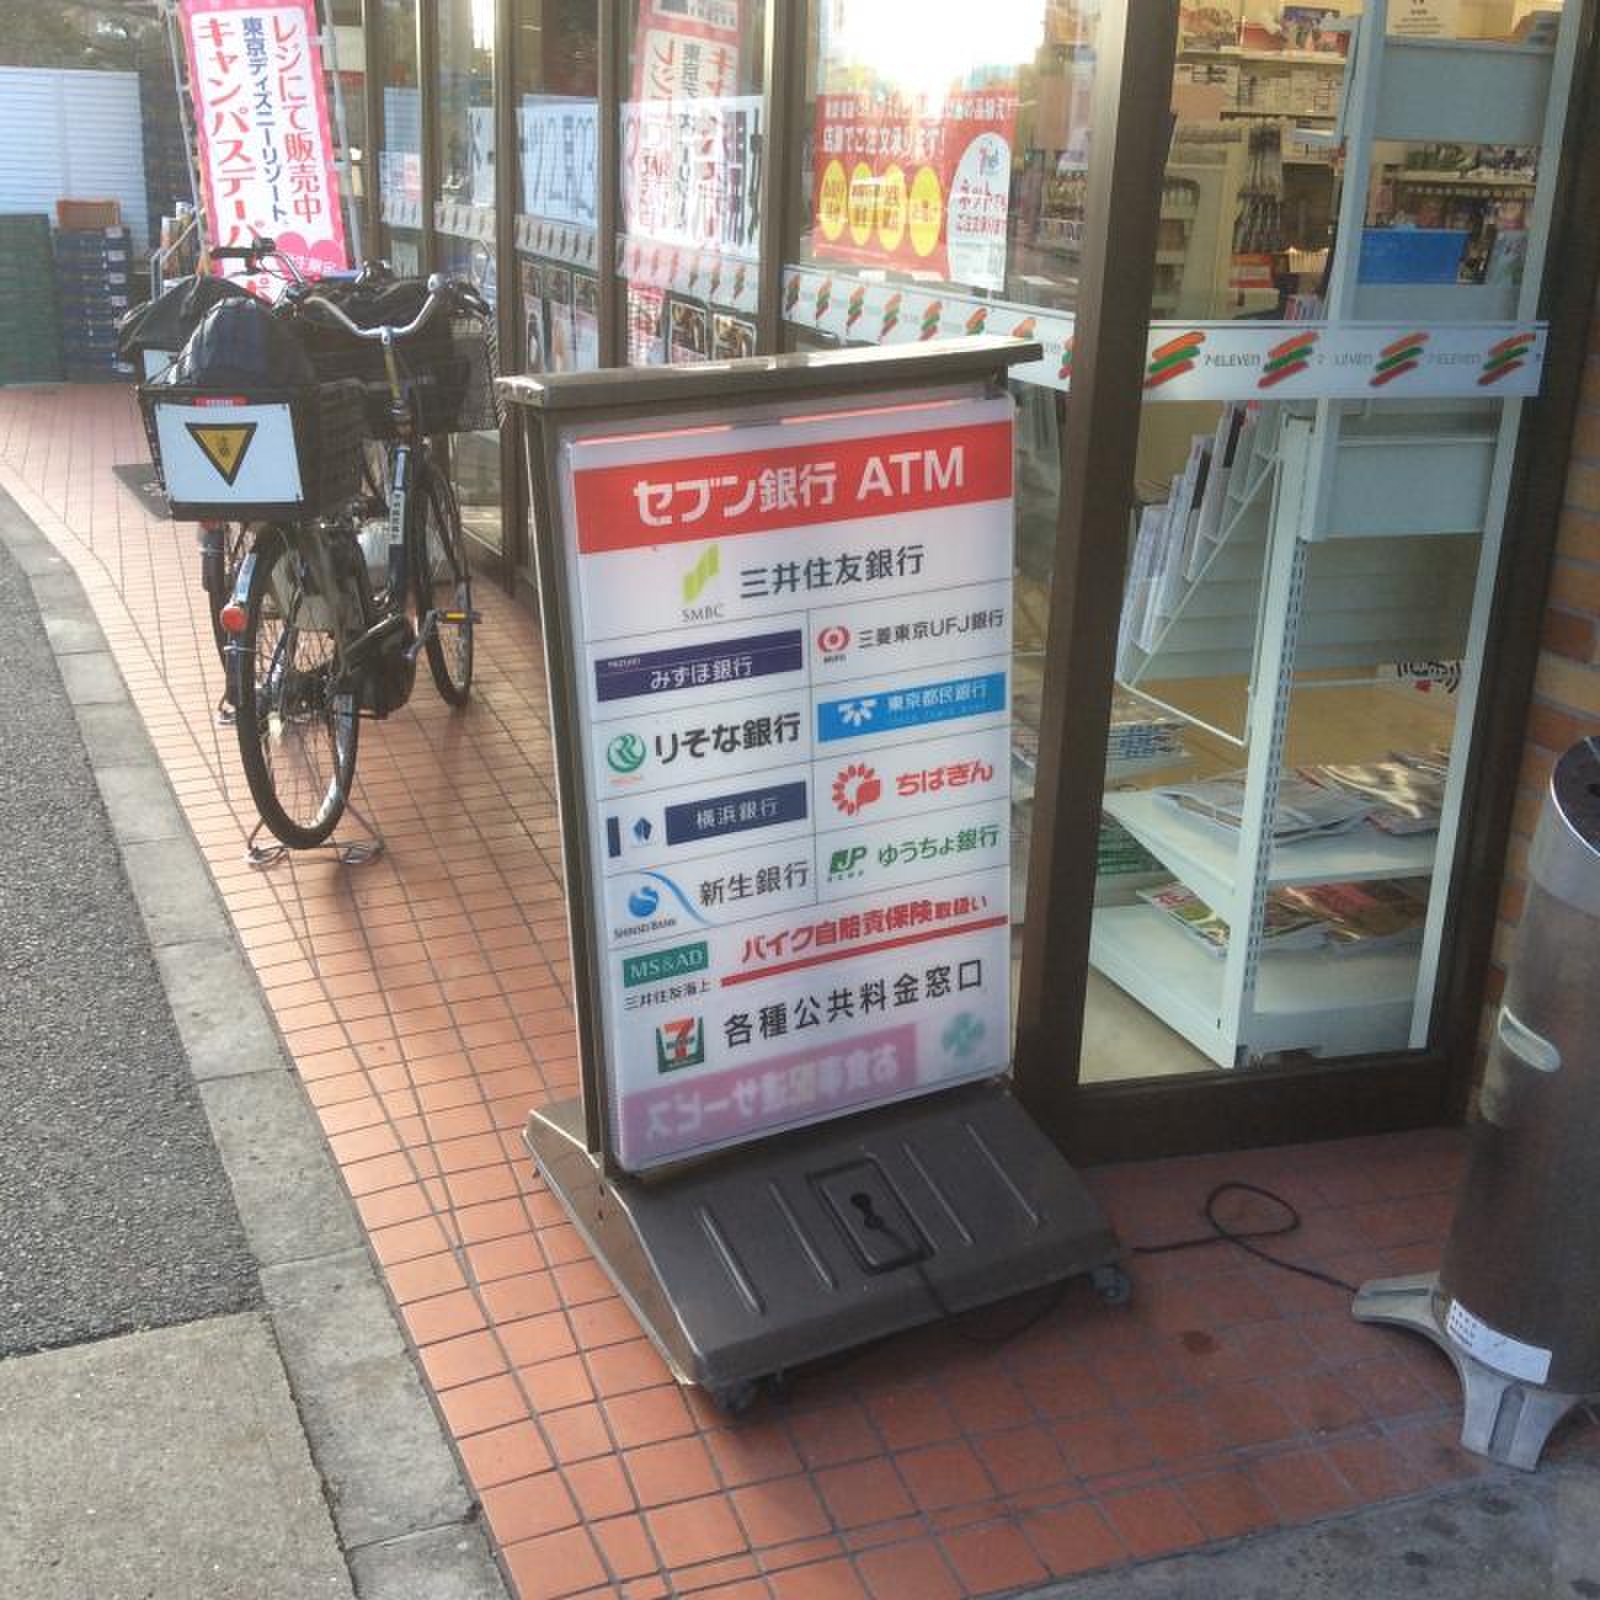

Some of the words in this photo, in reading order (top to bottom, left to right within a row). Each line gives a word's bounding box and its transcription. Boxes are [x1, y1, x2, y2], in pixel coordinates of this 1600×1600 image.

[272, 15, 322, 225] レジにて販売中
[633, 460, 838, 527] セブン銀行
[856, 446, 965, 501] ATM
[740, 543, 924, 599] 三井住友銀行
[681, 603, 725, 623] SMBC
[858, 608, 1004, 649] 三菱東京UFJ銀行
[650, 655, 753, 689] みずほ銀行
[655, 712, 801, 764] りそな銀行
[896, 760, 993, 797] ちばぎん
[696, 797, 779, 829] 横浜銀行
[879, 823, 1000, 867] ゆうちょ銀行
[700, 861, 809, 907] 新生銀行
[630, 949, 704, 979] MS&AD
[723, 959, 983, 1049] 各種公共料金窓口
